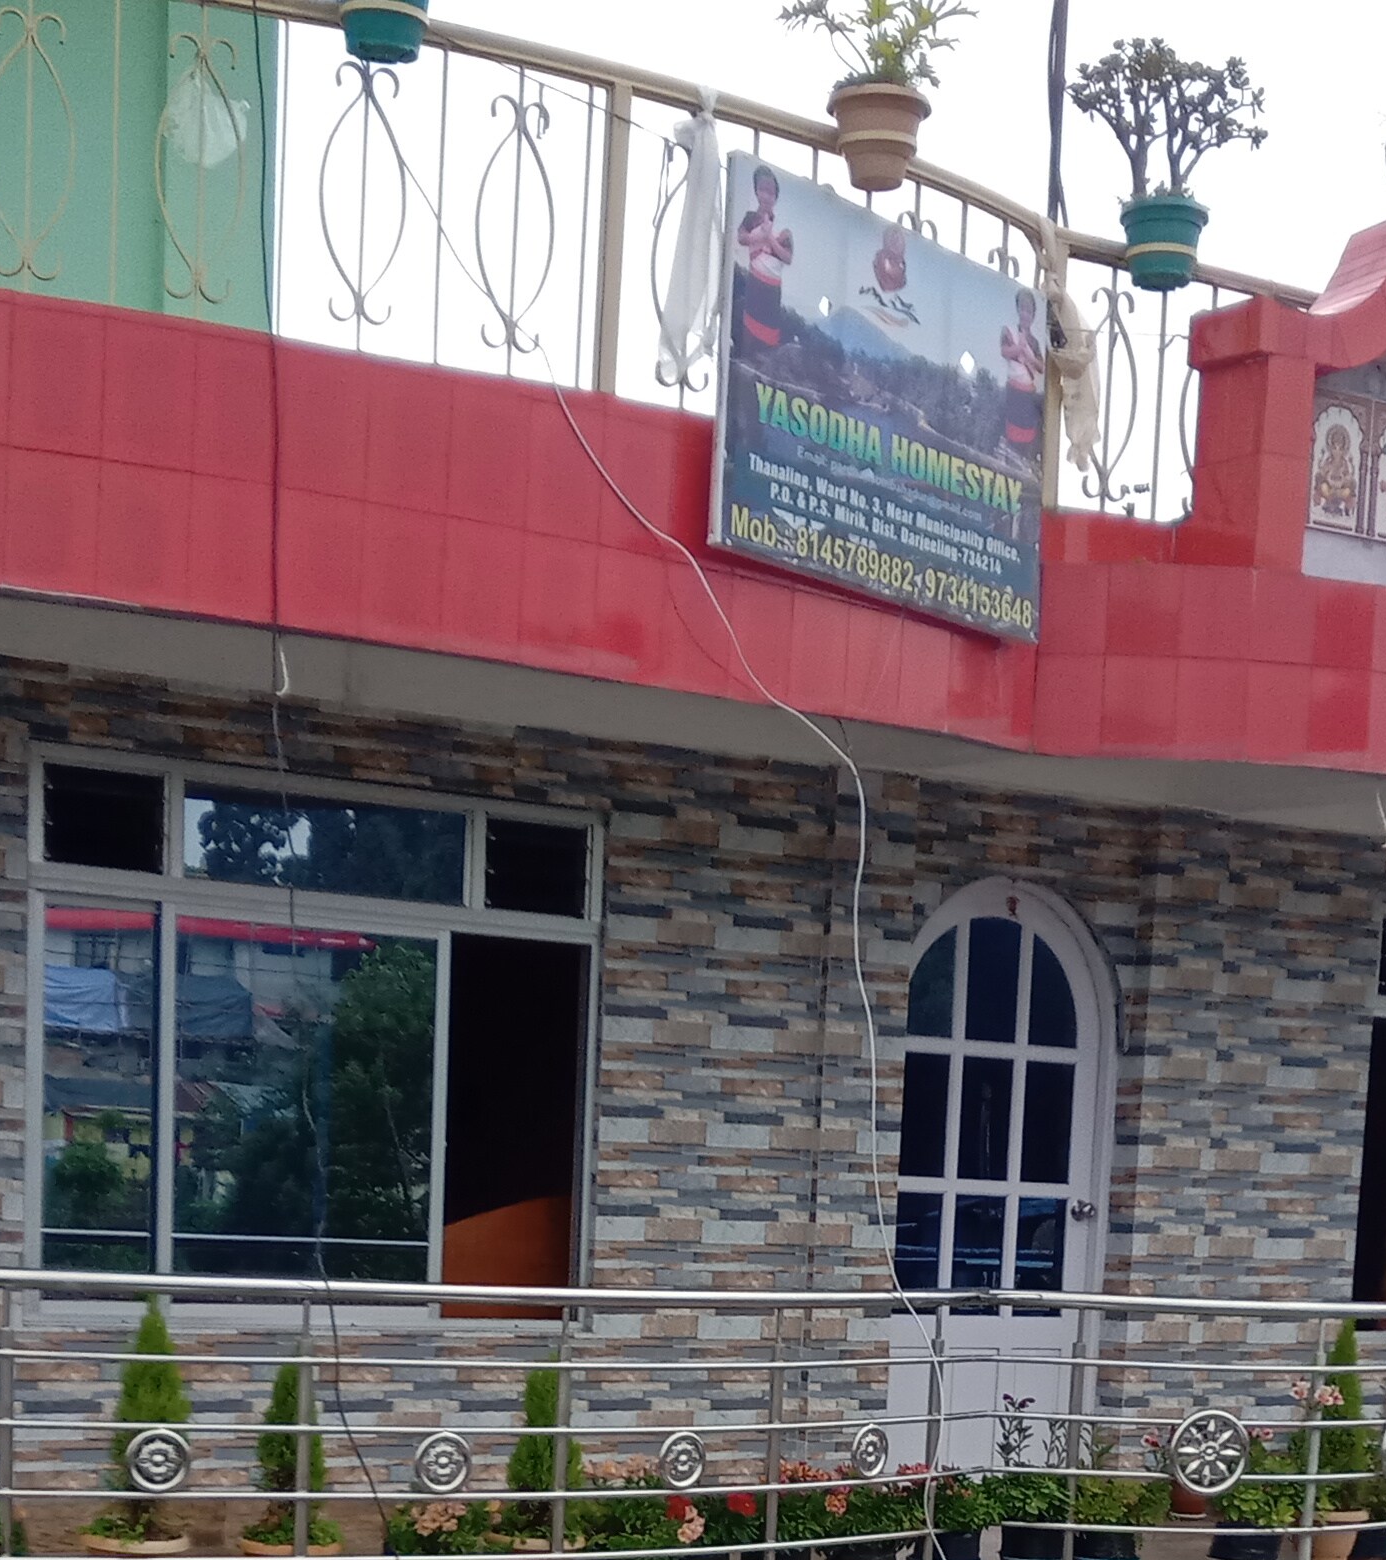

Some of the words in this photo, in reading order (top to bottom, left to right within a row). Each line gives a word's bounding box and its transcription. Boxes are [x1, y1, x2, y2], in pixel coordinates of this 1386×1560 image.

[756, 381, 883, 465] YASODHA
[891, 433, 1023, 515] HOMESTAY
[770, 480, 794, 505] P.O.
[796, 490, 806, 510] &
[809, 494, 832, 518] P.S.
[900, 526, 1003, 575] Darjeeling-734214
[816, 475, 847, 502] Ward
[849, 487, 870, 511] No.
[886, 500, 914, 526] Near
[916, 511, 985, 552] Municipality
[924, 567, 1033, 630] 9734153648
